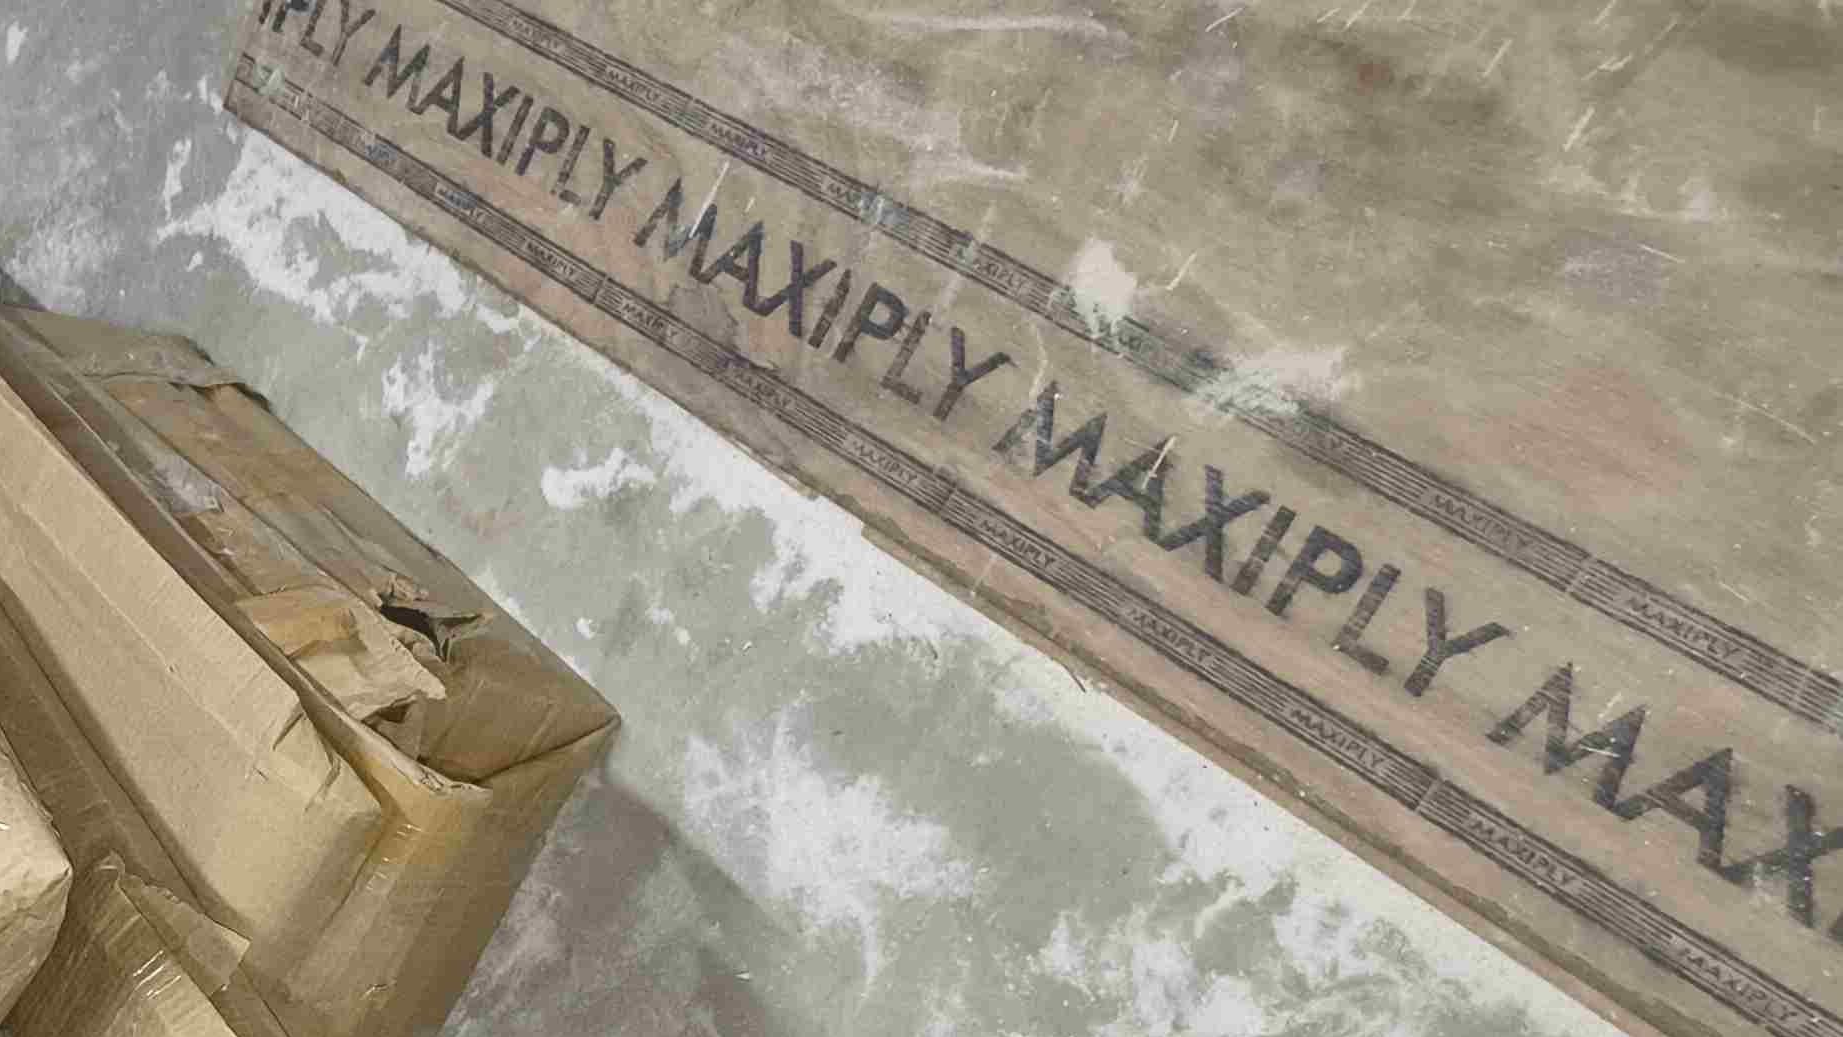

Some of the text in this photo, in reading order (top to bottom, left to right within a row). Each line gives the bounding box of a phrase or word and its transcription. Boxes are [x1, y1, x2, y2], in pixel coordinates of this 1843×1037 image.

[363, 24, 647, 220] MAXIPLY
[632, 176, 1010, 420] MAXIPLY
[991, 380, 1514, 697] MAXIPLY
[1485, 660, 1843, 943] MAX
[527, 239, 577, 277] MAXIPLY
[621, 301, 679, 344] MAXIPLY
[855, 443, 919, 483] MAXIPLY
[979, 517, 1056, 567] MAXIPLY
[1127, 606, 1211, 663] MAXIPLY
[1289, 708, 1391, 769] MAXIPLY
[1469, 818, 1579, 886] MAXIPLY
[1683, 948, 1799, 1020] MAXIPLY
[1435, 492, 1531, 549] MAXIPLY
[1624, 594, 1742, 658] MAXIPLY
